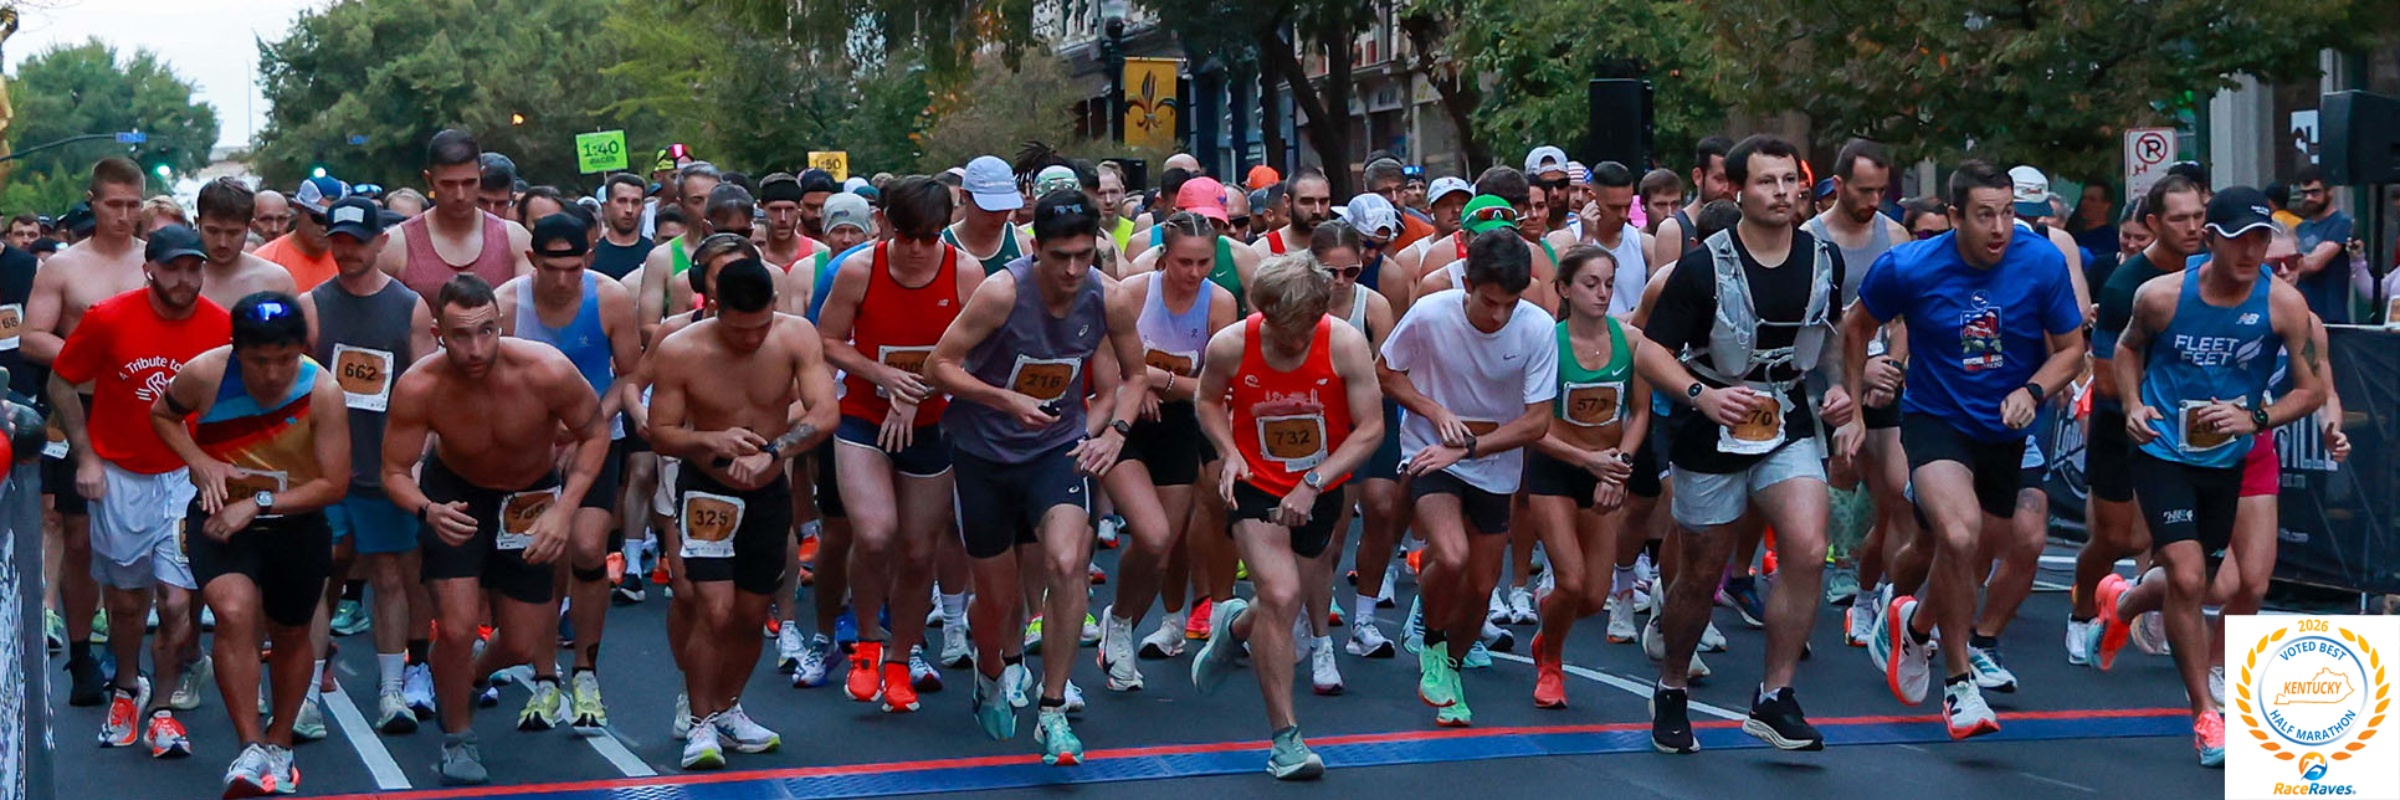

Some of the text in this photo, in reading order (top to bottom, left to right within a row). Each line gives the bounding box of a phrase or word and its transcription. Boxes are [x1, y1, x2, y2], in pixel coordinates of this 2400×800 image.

[583, 140, 620, 157] 1:40
[2174, 334, 2239, 352] FLEET
[124, 356, 168, 374] Tribute
[169, 358, 183, 373] to
[2180, 351, 2232, 366] FEET
[345, 362, 377, 382] 662
[1273, 429, 1310, 445] 732
[694, 509, 728, 527] 325
